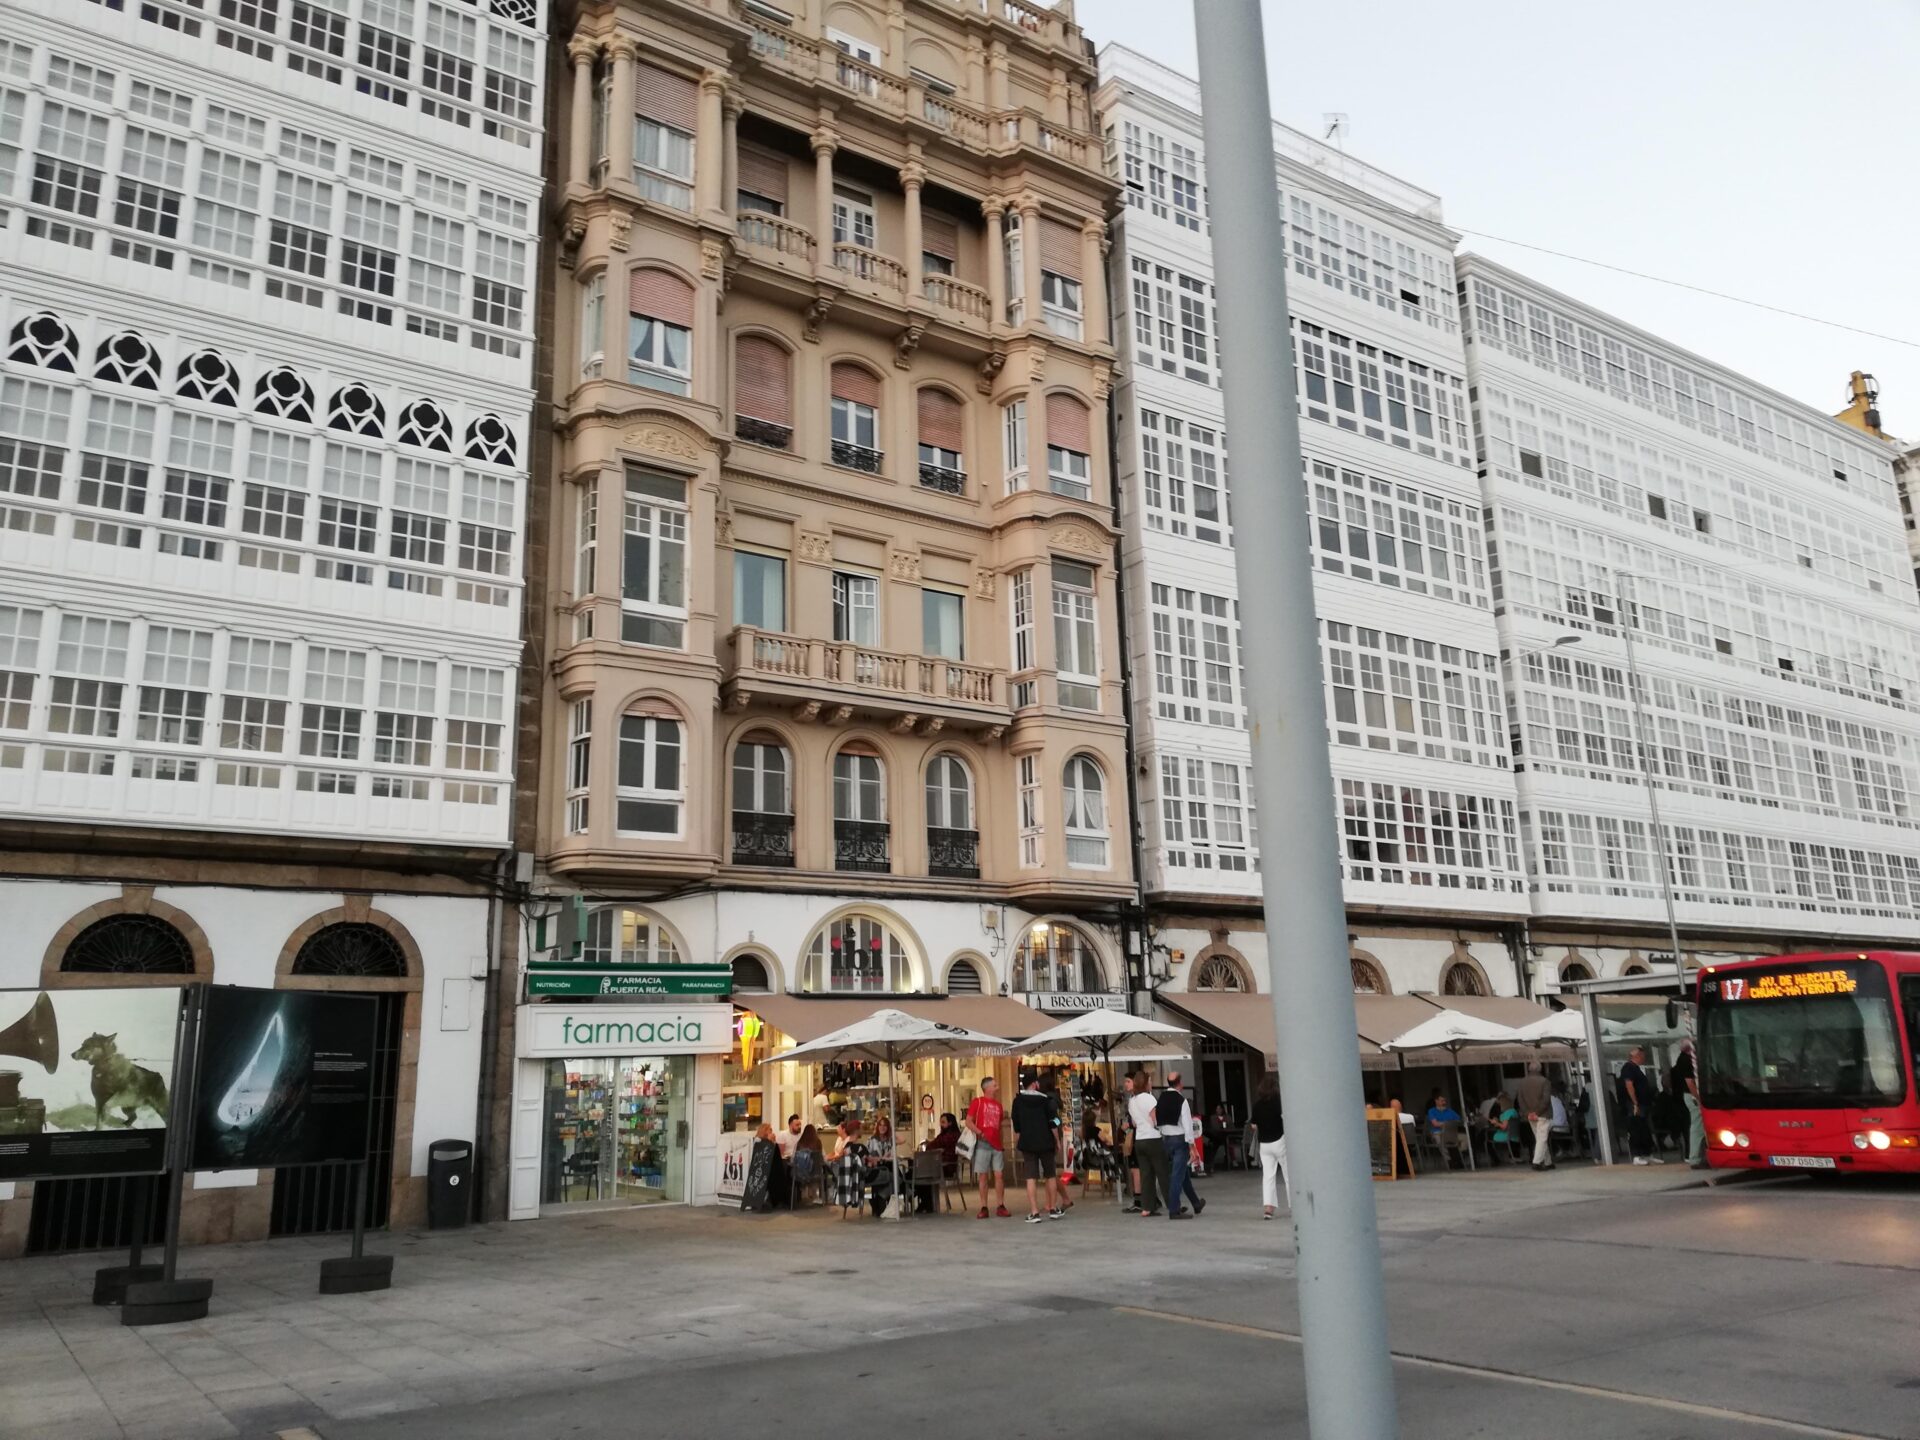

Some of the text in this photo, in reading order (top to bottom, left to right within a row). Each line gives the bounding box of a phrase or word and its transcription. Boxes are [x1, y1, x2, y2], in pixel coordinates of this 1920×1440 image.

[616, 976, 662, 985] FARMACIA
[1779, 974, 1793, 986] DE
[610, 986, 669, 994] PUERTA REAL
[1726, 979, 1743, 1000] 17
[562, 1015, 702, 1045] farmacia
